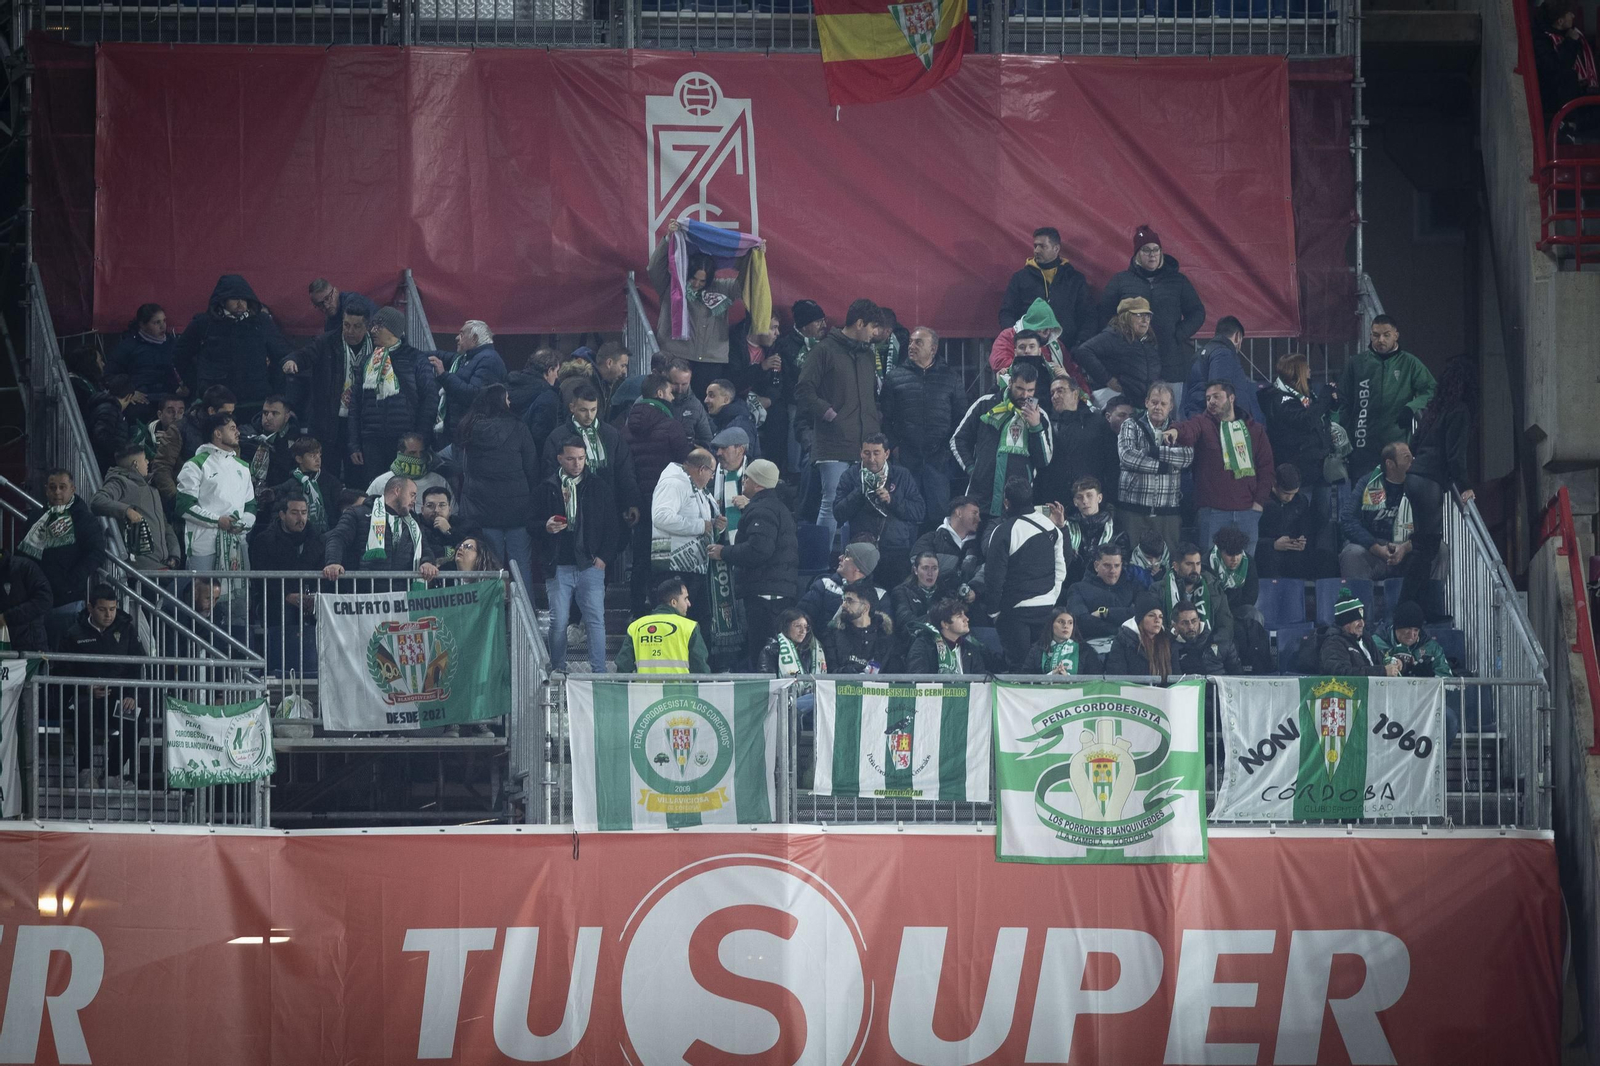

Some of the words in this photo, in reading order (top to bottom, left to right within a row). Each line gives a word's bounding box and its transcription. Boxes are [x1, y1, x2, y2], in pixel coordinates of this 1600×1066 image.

[333, 601, 391, 615] CALIFATO
[394, 590, 478, 613] BLANQUIVERDE
[652, 649, 661, 657] 25
[386, 712, 420, 724] DESDE
[423, 708, 446, 722] 2021
[634, 729, 644, 748] PEÑA
[640, 700, 688, 729] CORDOBESISTA
[1074, 702, 1162, 725] CORDOBESISTA
[1372, 713, 1432, 759] 1960
[657, 796, 709, 804] VILLAVICIOSA
[1048, 813, 1063, 826] LOS
[1064, 820, 1105, 836] PORRONES
[1106, 810, 1165, 836] BLANQUIVERDES
[1060, 830, 1070, 840] LA
[1071, 836, 1103, 845] RAMBLA
